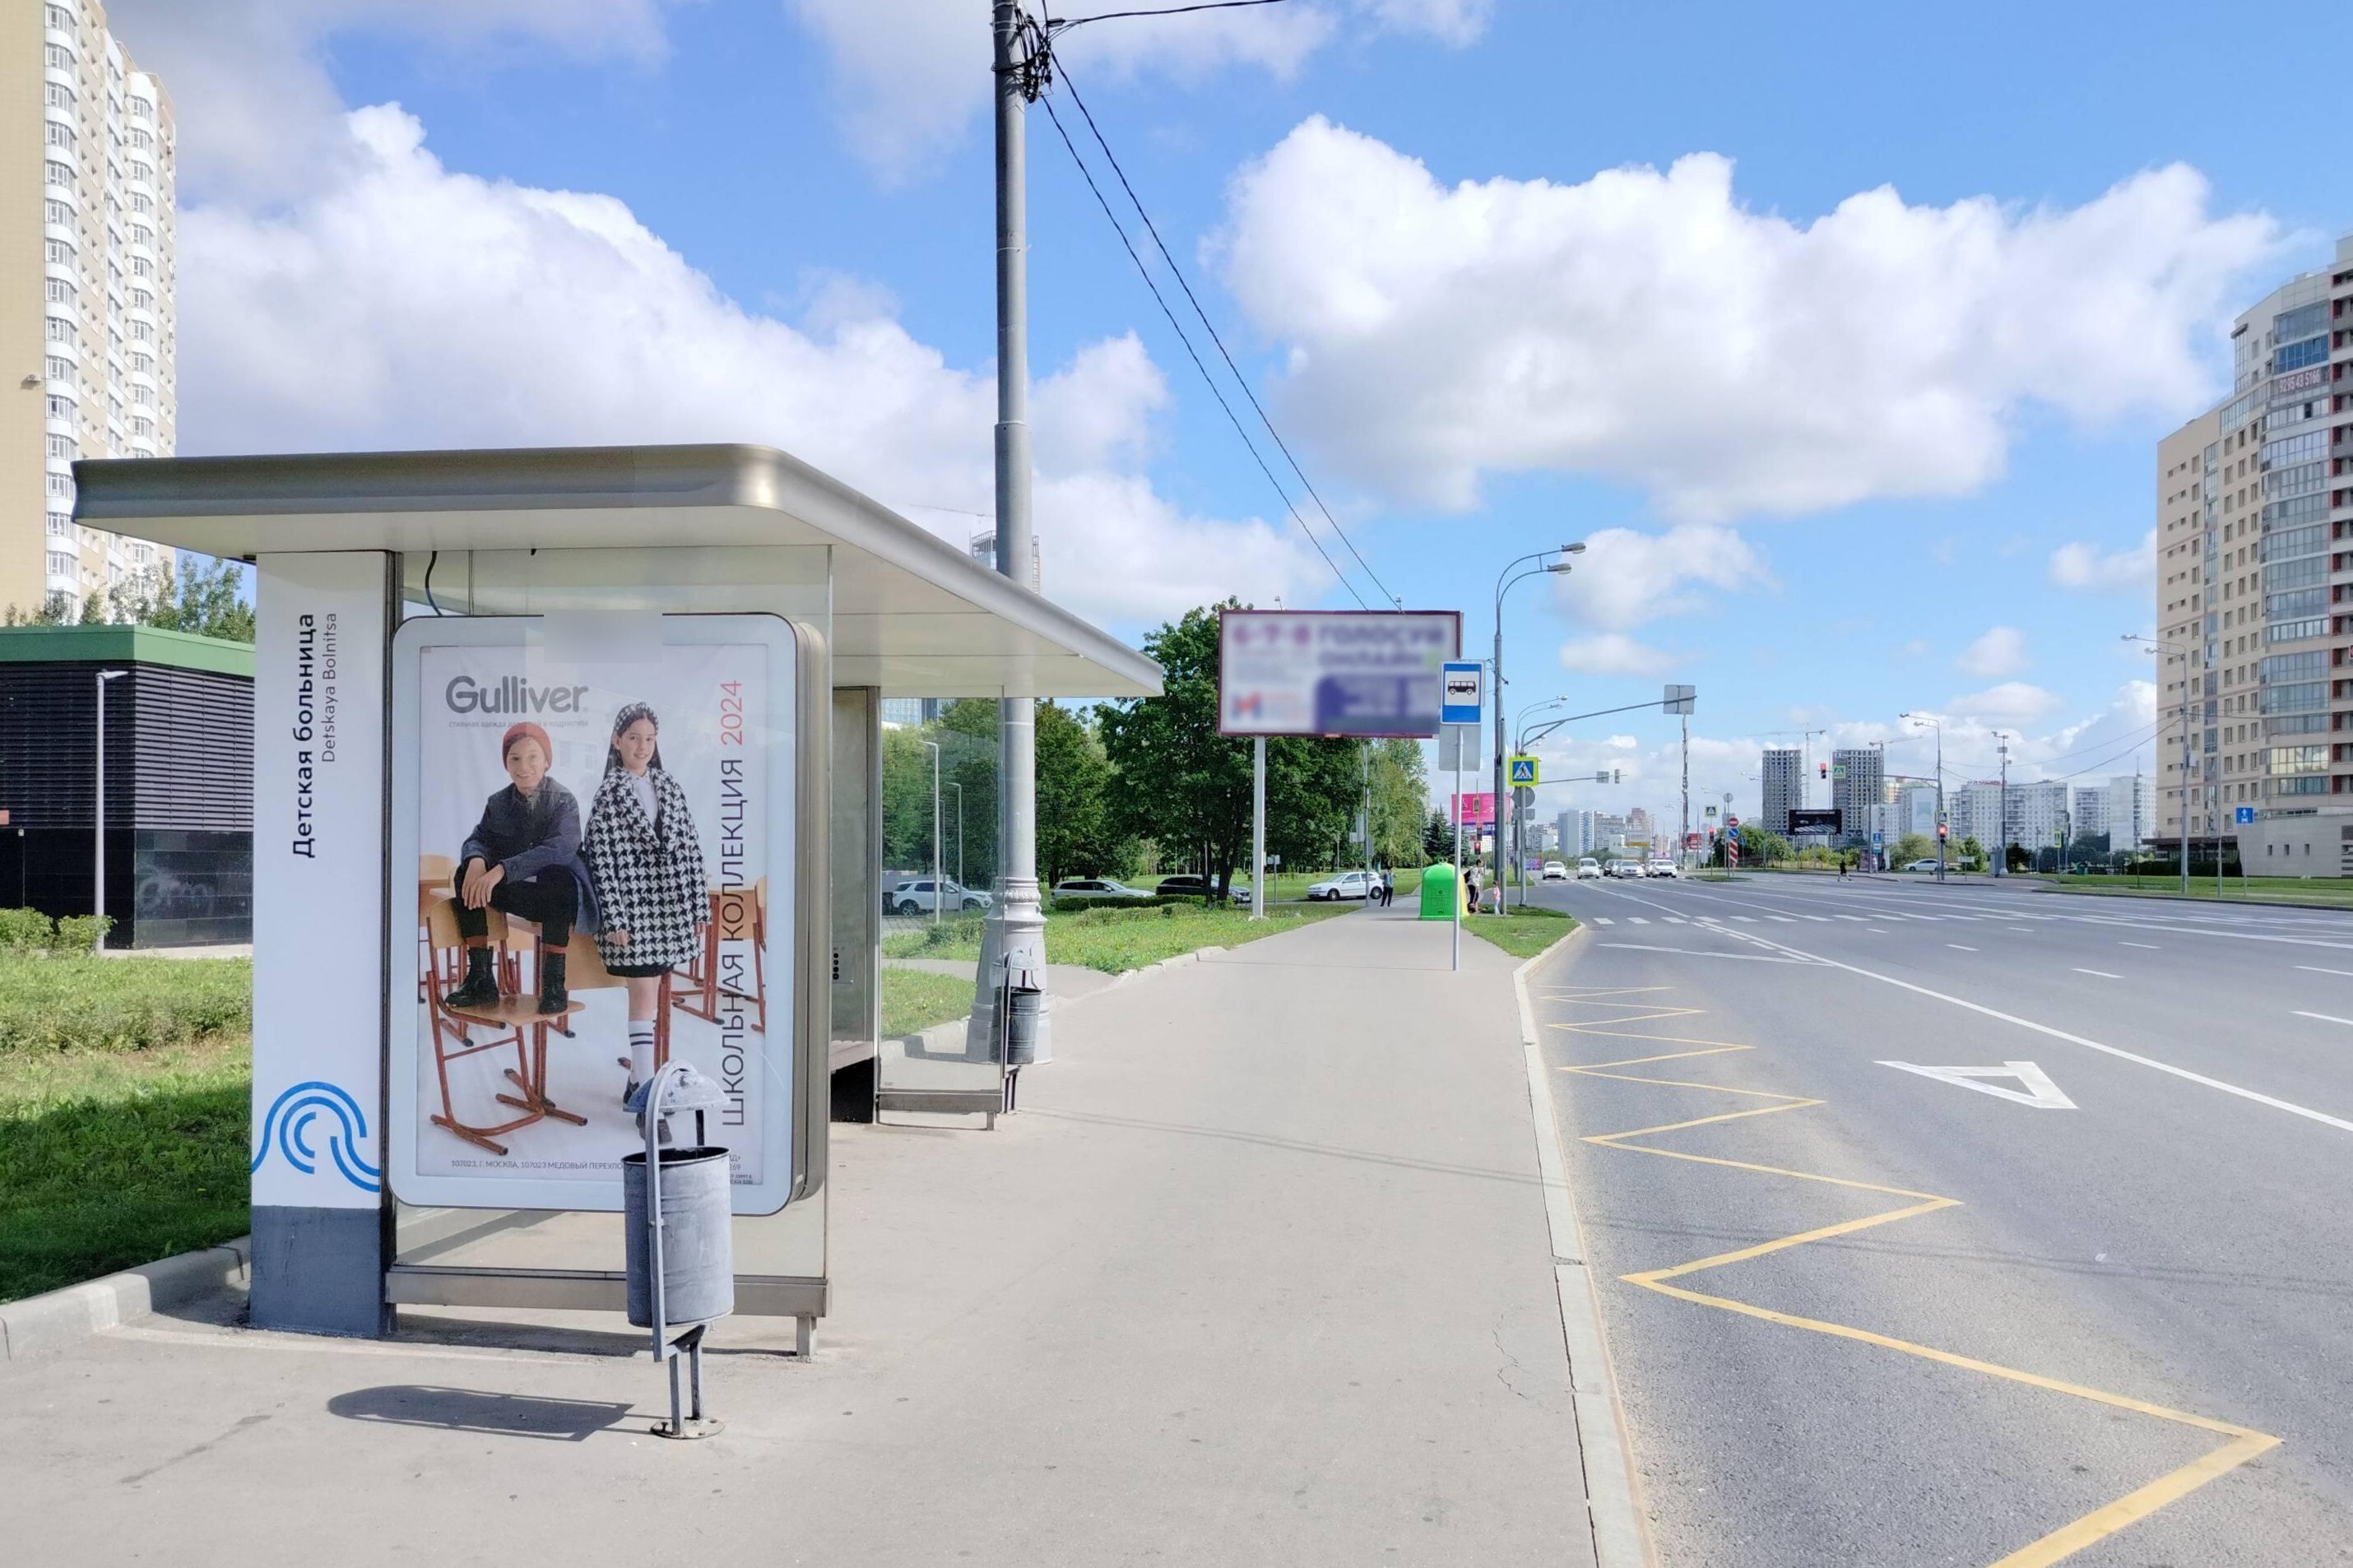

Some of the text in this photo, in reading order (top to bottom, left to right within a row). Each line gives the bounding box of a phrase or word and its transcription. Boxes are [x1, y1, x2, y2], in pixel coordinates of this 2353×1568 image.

[292, 614, 317, 858] Детская больница
[321, 613, 338, 762] Detskaya Bolnitsa
[446, 675, 589, 713] Gulliver
[720, 680, 748, 1125] ШКОЛЬНАЯ КОЛЛЕКЦИЯ 2024
[548, 1161, 587, 1170] МЕДОВЫЙ
[589, 1162, 624, 1170] ПЕРЕУЛО
